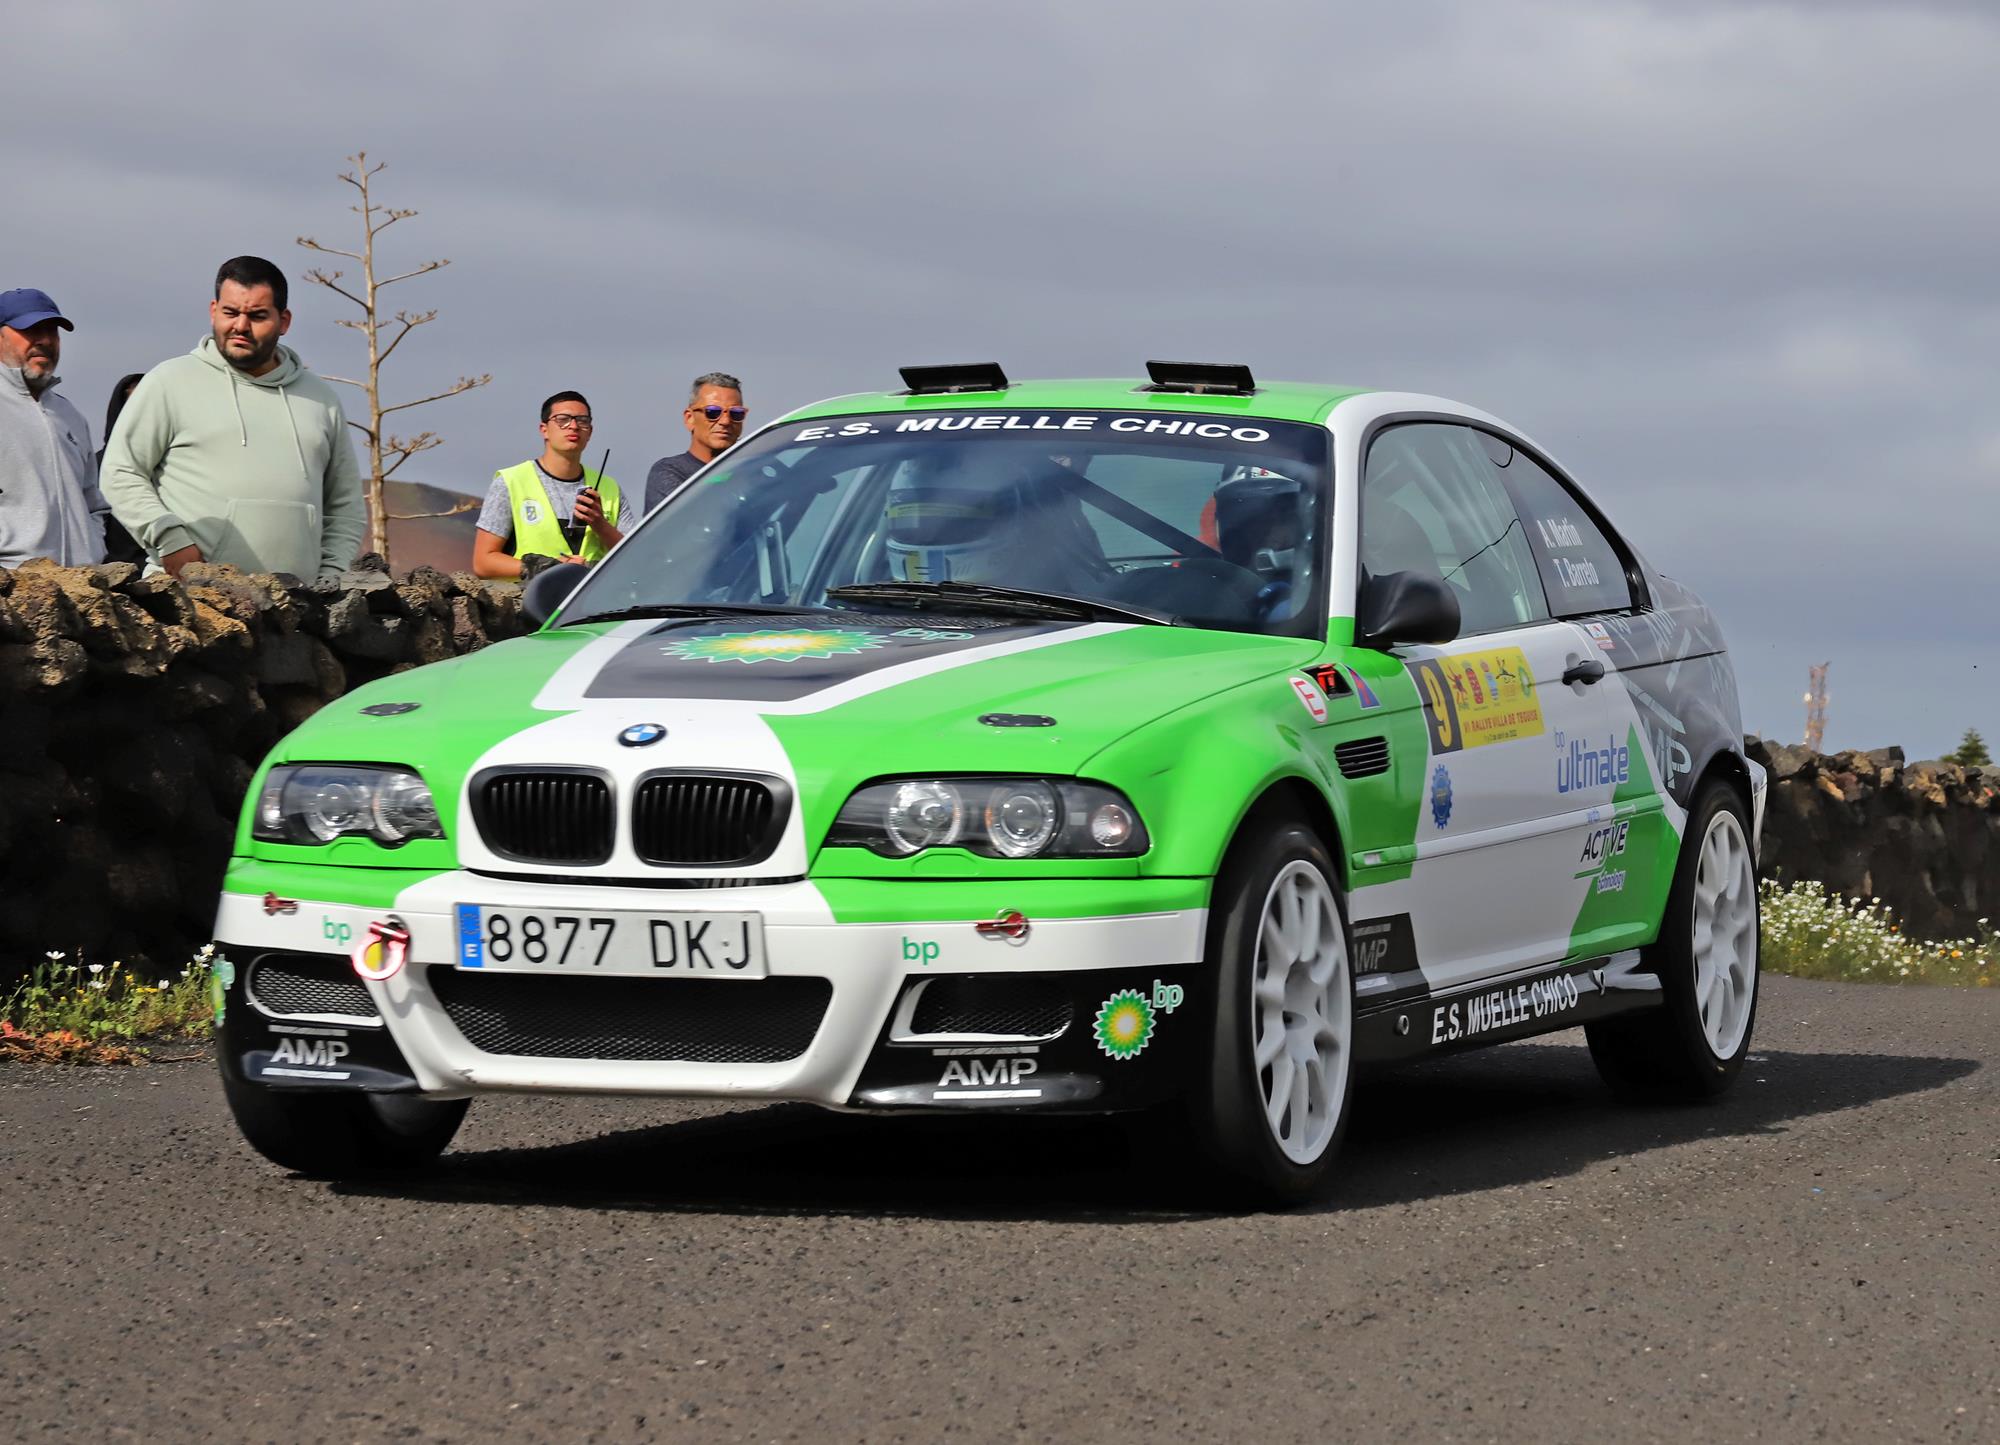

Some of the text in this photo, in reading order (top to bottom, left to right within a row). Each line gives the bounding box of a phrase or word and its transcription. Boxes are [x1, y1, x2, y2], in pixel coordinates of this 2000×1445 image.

[794, 415, 1270, 443] E.S. MUELLE CHICO
[890, 628, 975, 641] bp
[1420, 665, 1452, 748] 9
[1557, 733, 1629, 794] ultimate
[1580, 821, 1628, 863] ACTIVE
[322, 915, 352, 946] bp
[488, 914, 750, 970] 8877 DKJ
[465, 942, 478, 959] E
[902, 936, 940, 966] bp
[1153, 979, 1184, 1014] bp
[1432, 973, 1579, 1045] E.S. MUELLE CHICO
[270, 1038, 350, 1067] AMP
[938, 1057, 1039, 1087] AMP
